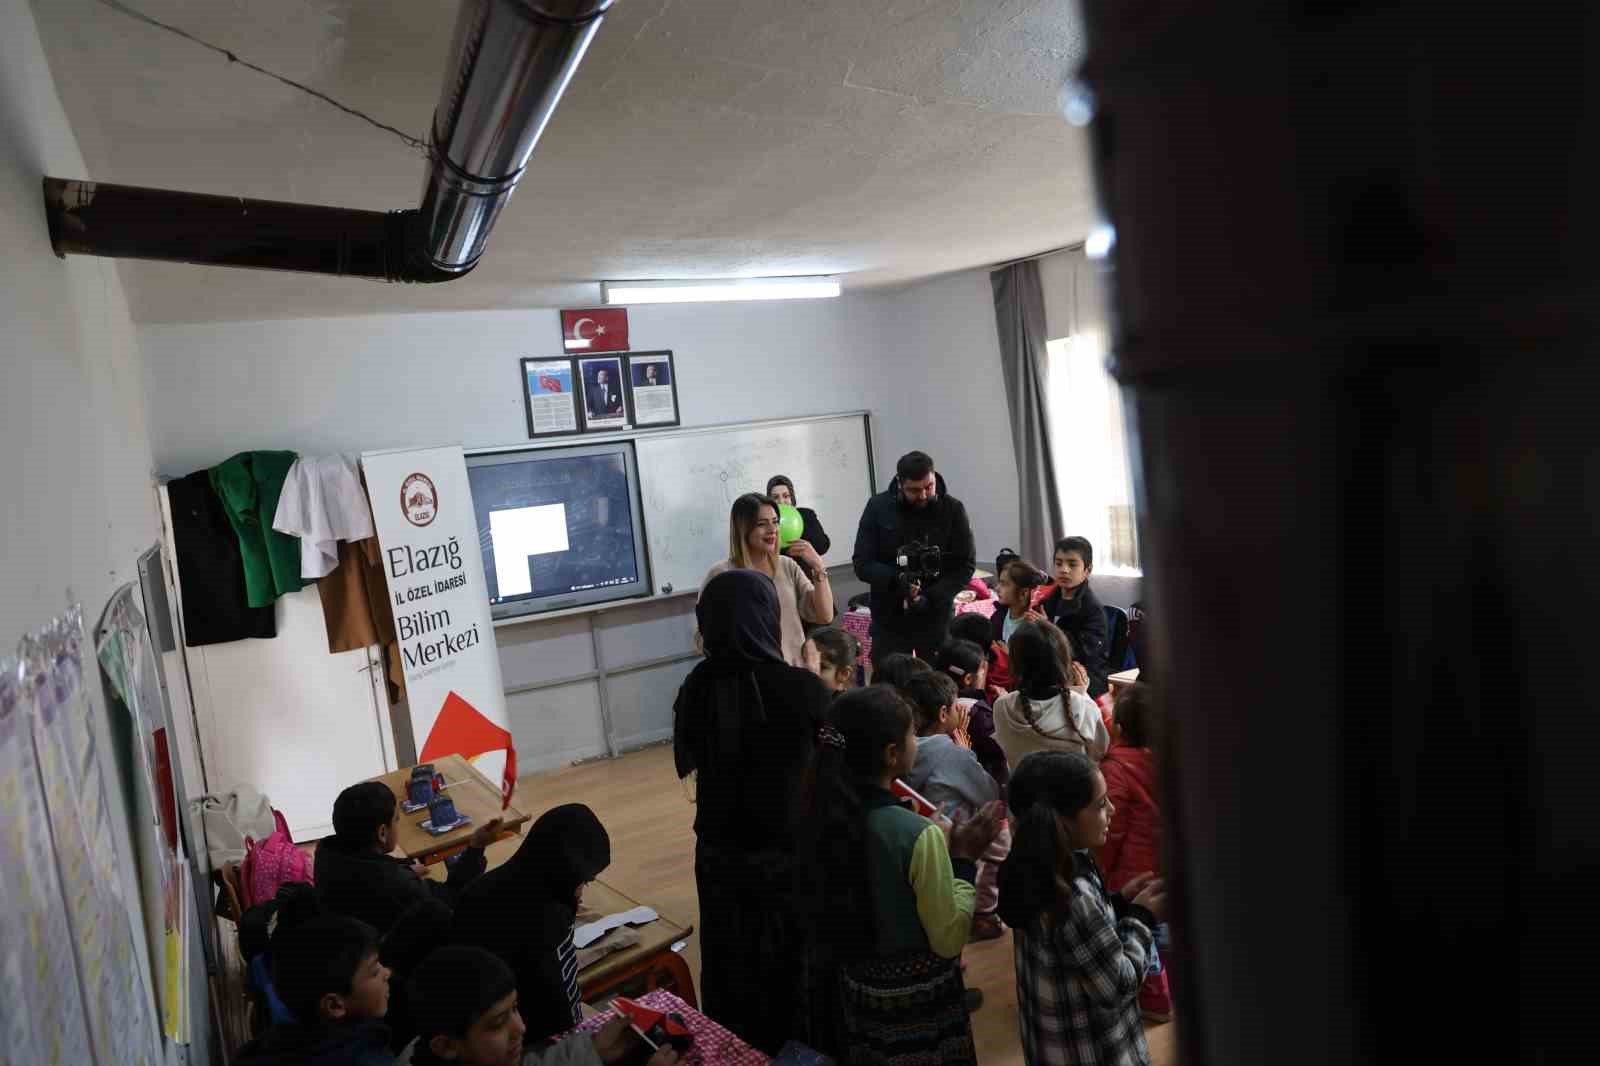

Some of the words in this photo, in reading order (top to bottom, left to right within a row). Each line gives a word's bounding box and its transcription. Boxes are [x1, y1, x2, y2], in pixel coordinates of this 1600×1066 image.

[387, 536, 463, 578] Elazığ
[395, 592, 405, 606] İL
[407, 585, 433, 602] ÖZEL
[434, 571, 467, 594] İDARESİ
[398, 609, 451, 641] Bilim
[403, 623, 480, 671] Merkezi
